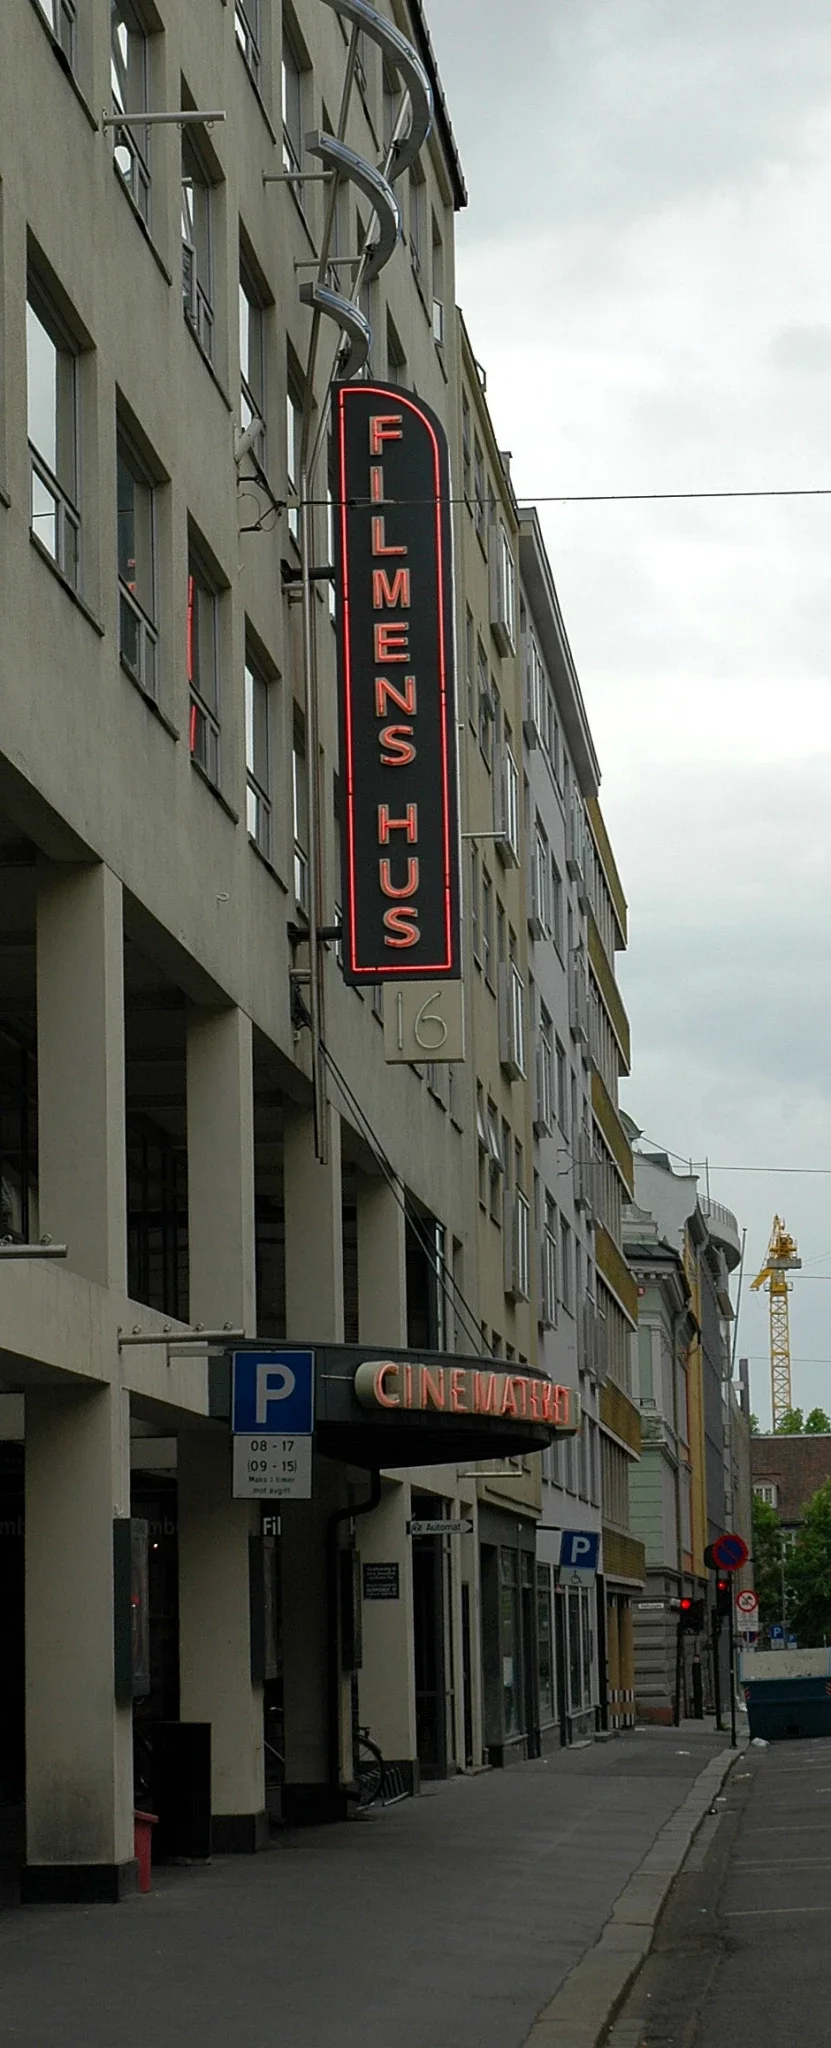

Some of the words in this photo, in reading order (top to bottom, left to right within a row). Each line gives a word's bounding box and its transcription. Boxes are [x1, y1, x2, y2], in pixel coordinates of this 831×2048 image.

[369, 414, 417, 767] FILMENS
[377, 802, 421, 951] HUS
[396, 989, 449, 1050] 16
[254, 1363, 296, 1424] P
[372, 1362, 572, 1425] CINEMATEKET
[247, 1460, 267, 1474] (09
[282, 1460, 297, 1473] 15)
[250, 1440, 267, 1452] 08
[282, 1440, 294, 1452] 17
[426, 1523, 461, 1532] Automat
[572, 1536, 591, 1563] P
[774, 1627, 783, 1638] P
